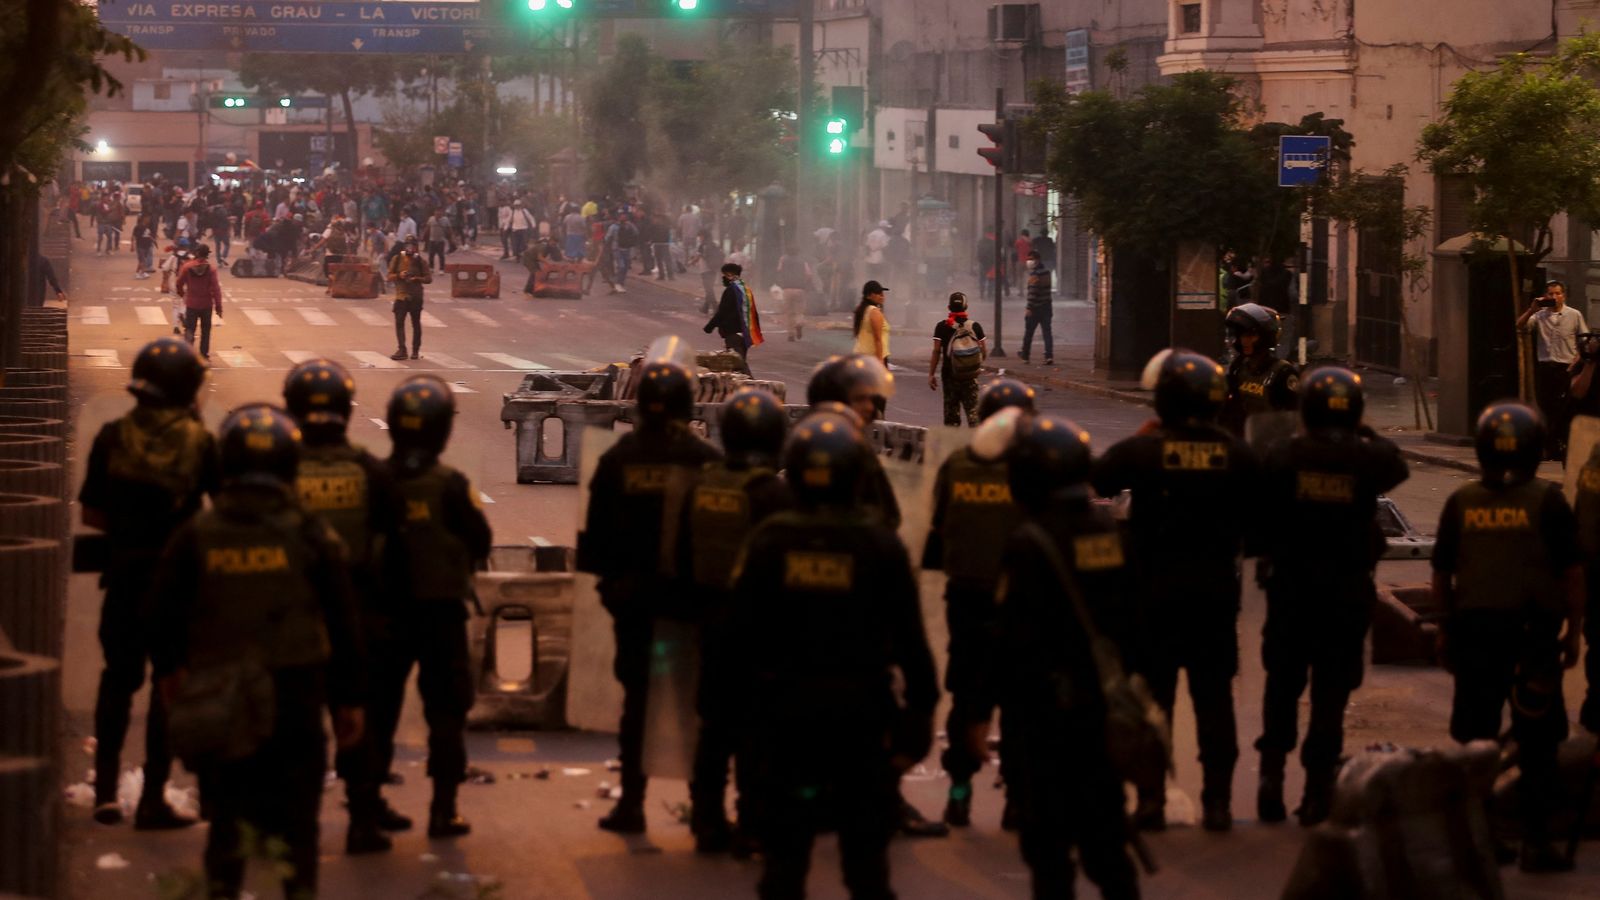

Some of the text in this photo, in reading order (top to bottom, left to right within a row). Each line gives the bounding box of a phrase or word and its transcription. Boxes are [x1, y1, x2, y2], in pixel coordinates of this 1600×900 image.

[127, 4, 156, 17] VIA
[170, 4, 257, 18] EXPRESA
[270, 5, 322, 19] GRAU
[360, 7, 385, 20] LA
[411, 7, 481, 21] VICTORI
[126, 25, 175, 35] TRANSP
[222, 26, 276, 37] PRVADO
[372, 28, 421, 38] TRANSP
[953, 482, 1012, 503] POLICIA
[1463, 508, 1530, 529] POLICIA
[206, 547, 289, 574] POLICIA
